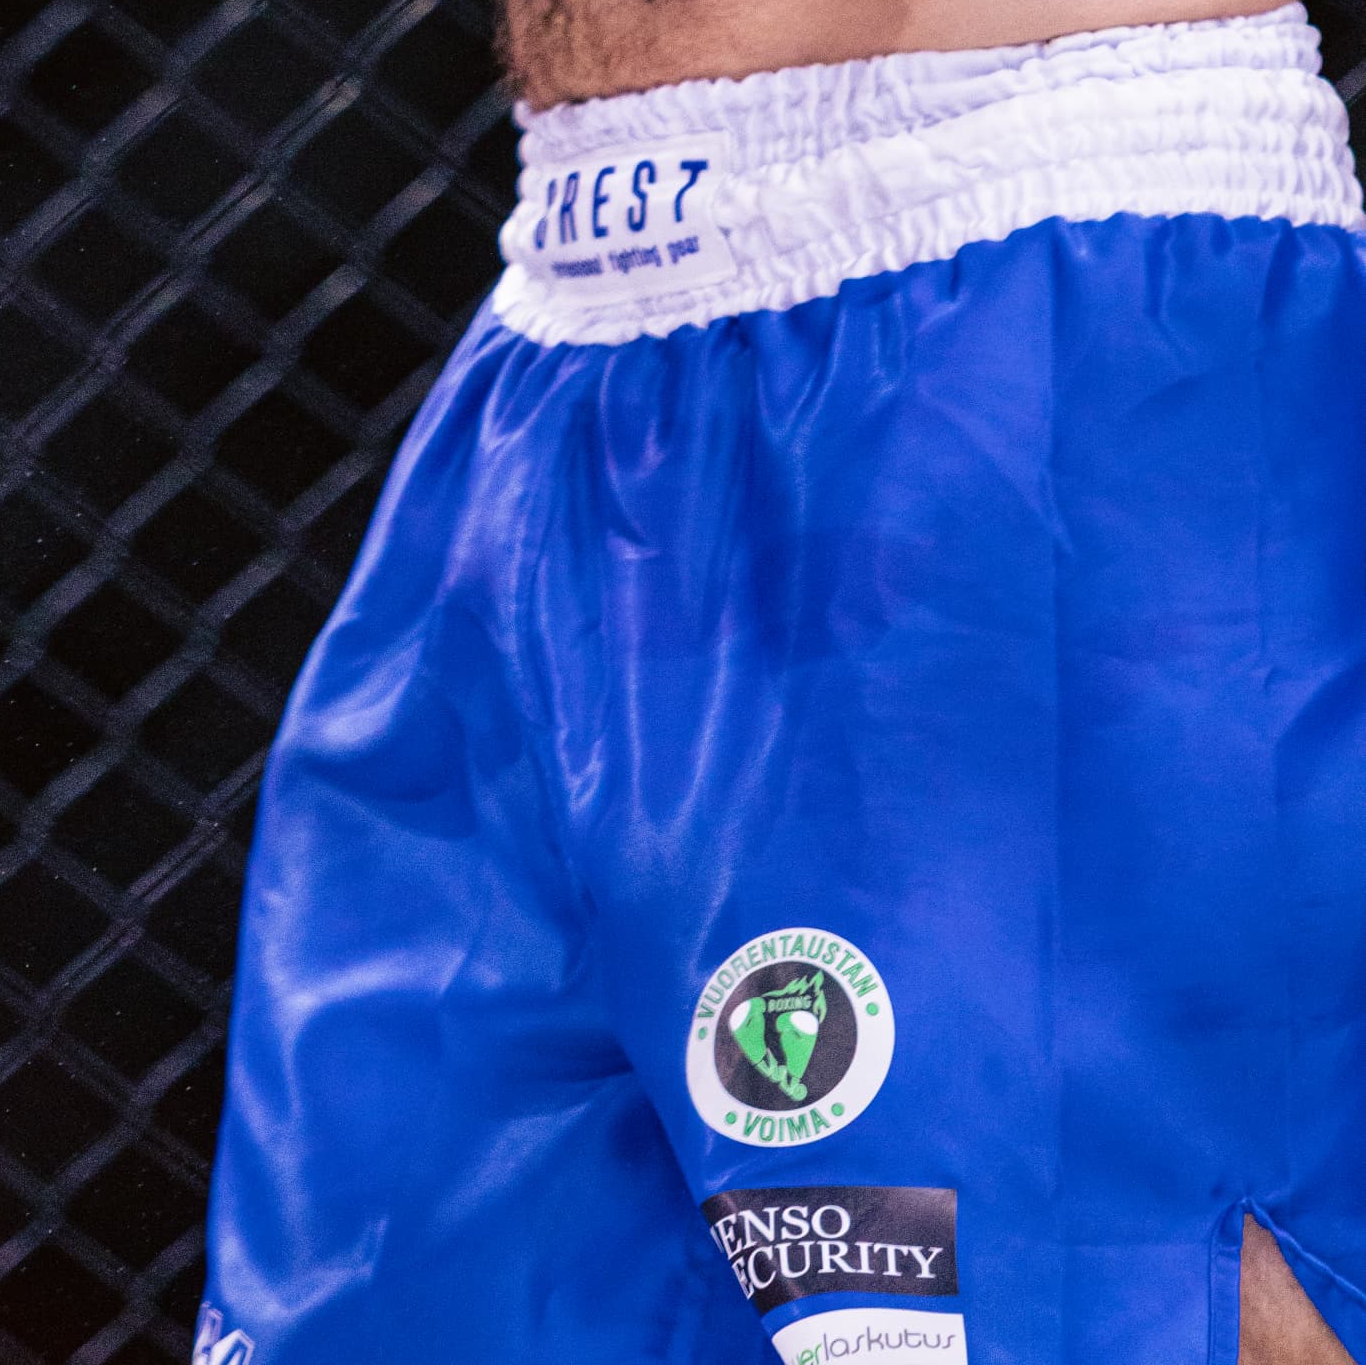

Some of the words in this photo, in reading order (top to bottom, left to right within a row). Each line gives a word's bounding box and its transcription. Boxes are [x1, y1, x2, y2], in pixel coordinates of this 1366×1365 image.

[697, 934, 879, 1019] VUORENTAUSTAN
[767, 994, 812, 1014] BOXING
[742, 1107, 831, 1143] VOIMA
[792, 1326, 956, 1365] erlaskutus
